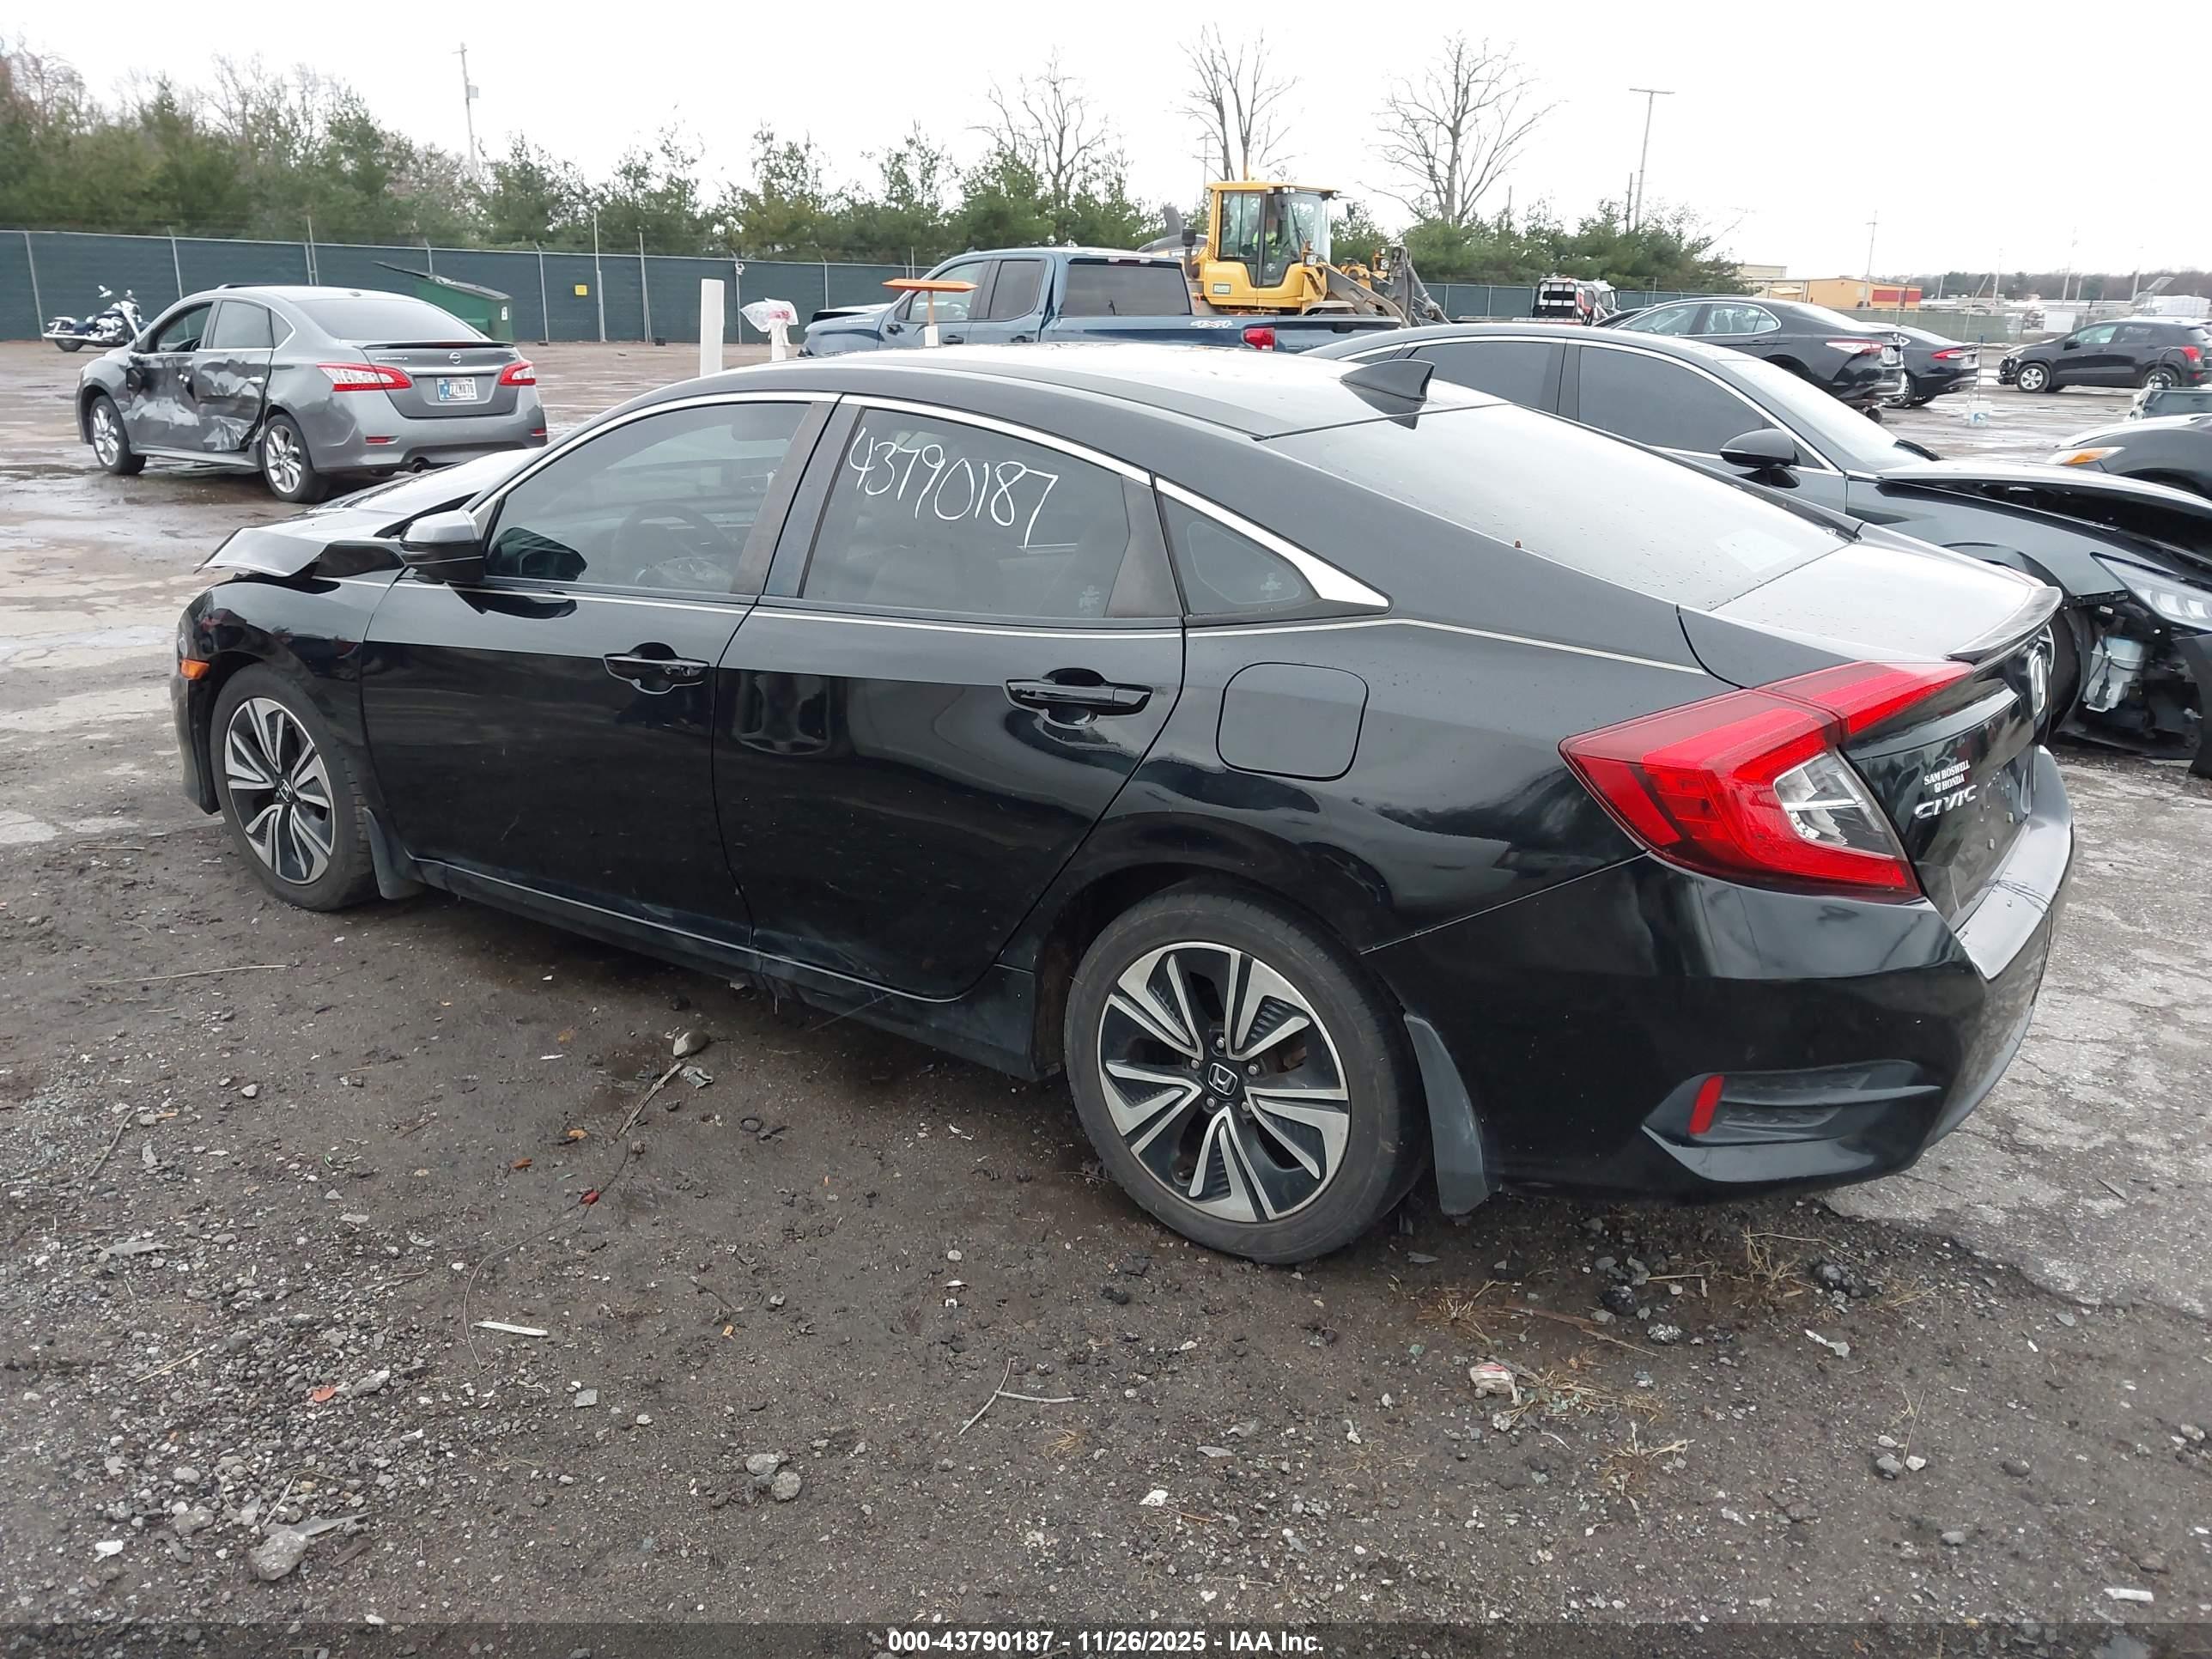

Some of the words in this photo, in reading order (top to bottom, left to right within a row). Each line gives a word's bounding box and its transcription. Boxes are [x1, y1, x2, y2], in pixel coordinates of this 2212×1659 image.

[848, 427, 1059, 550] 43790187
[1923, 771, 1941, 786] SAM
[1942, 759, 1971, 780] BOSWELL
[1942, 773, 1965, 791] HONDA
[1915, 784, 1978, 819] CIVIC
